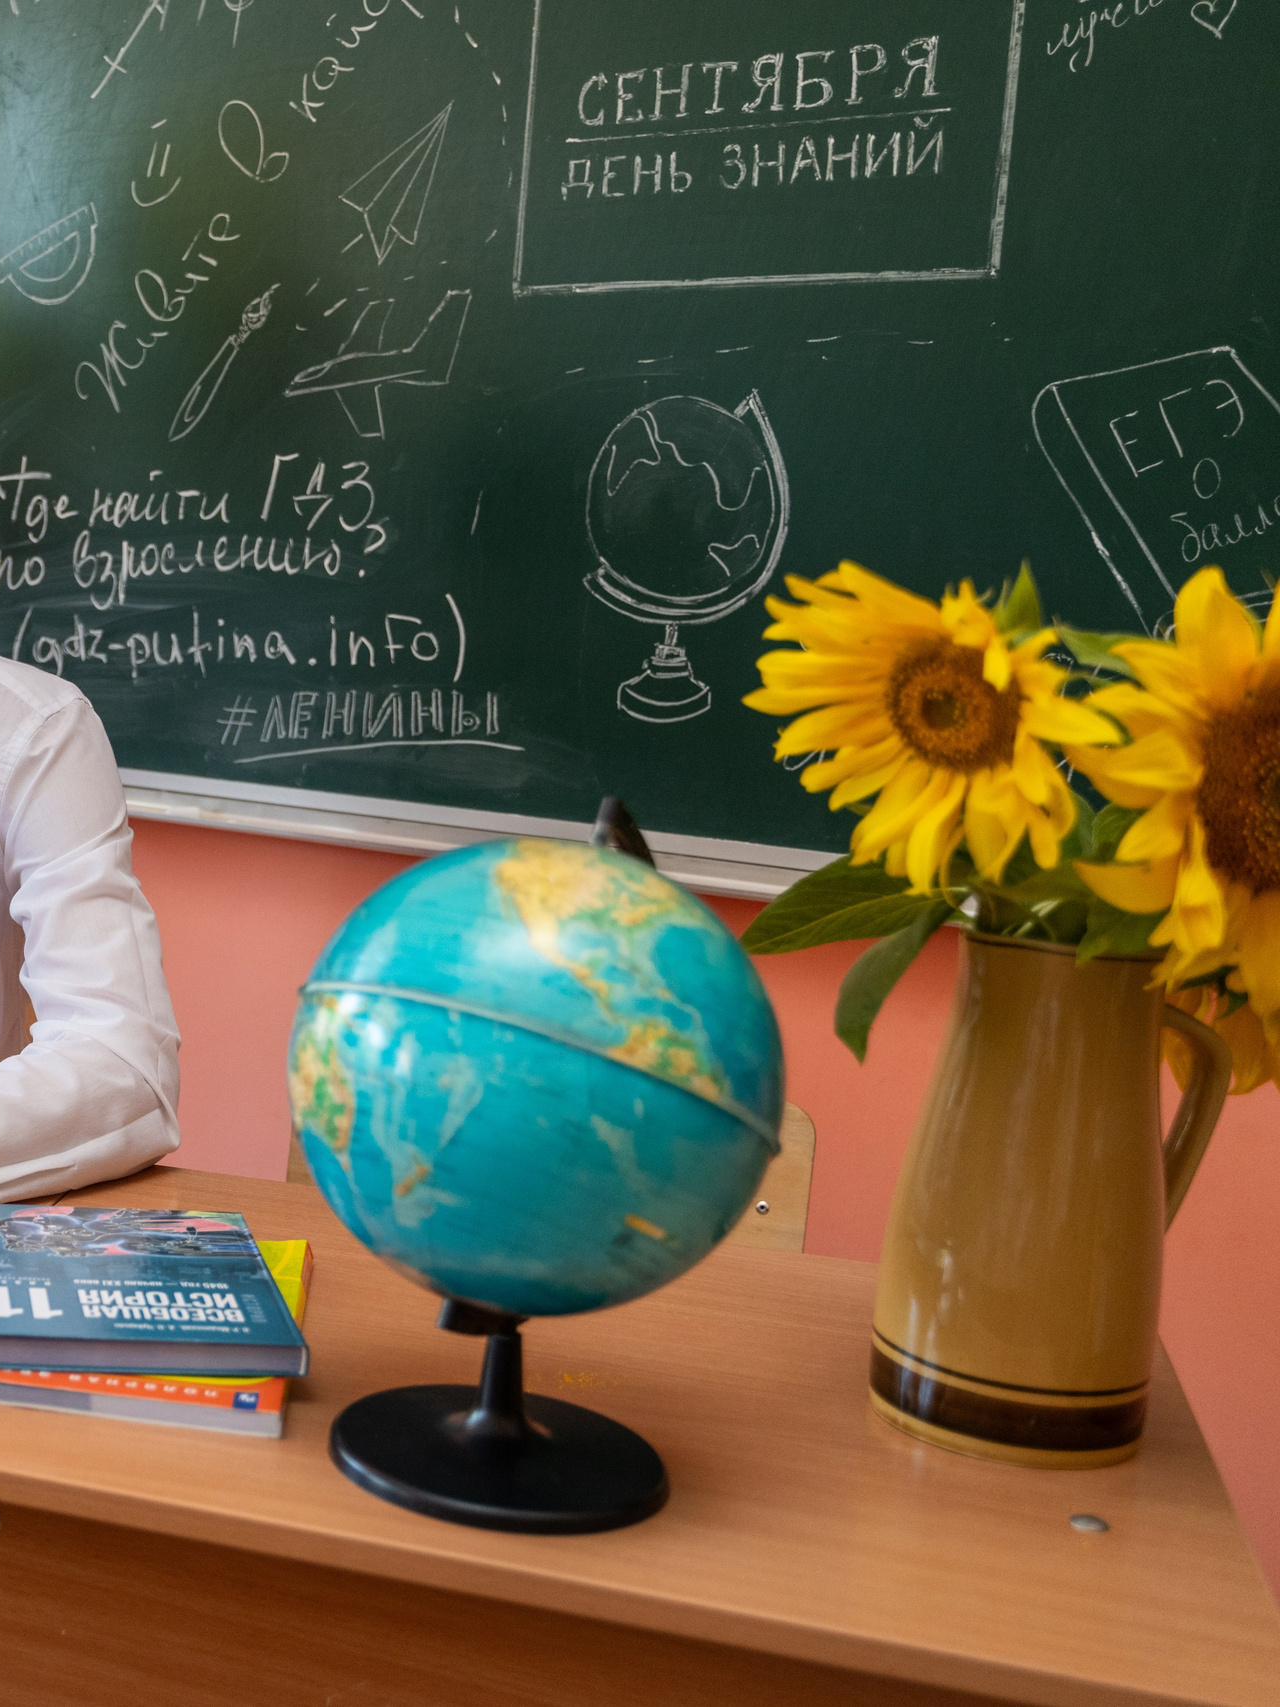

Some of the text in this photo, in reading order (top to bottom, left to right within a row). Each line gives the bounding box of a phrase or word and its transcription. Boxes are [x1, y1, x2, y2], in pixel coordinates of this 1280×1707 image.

[578, 35, 939, 126] СЕНТЯБРЯ
[561, 115, 943, 200] ДЕНЬ ЗНАНИЙ
[74, 213, 240, 413] Живите
[1109, 379, 1244, 477] ЕГЭ
[89, 470, 230, 529] найти
[261, 453, 377, 531] ГДЗ
[1170, 494, 1280, 562] балл
[219, 688, 500, 745] #ЛЕНИНЫ
[77, 1289, 238, 1309] ИСТОРИЯ
[82, 1304, 246, 1324] ВСЕОБЩАЯ
[68, 1373, 218, 1398] ПОЛЯРНАЯ
